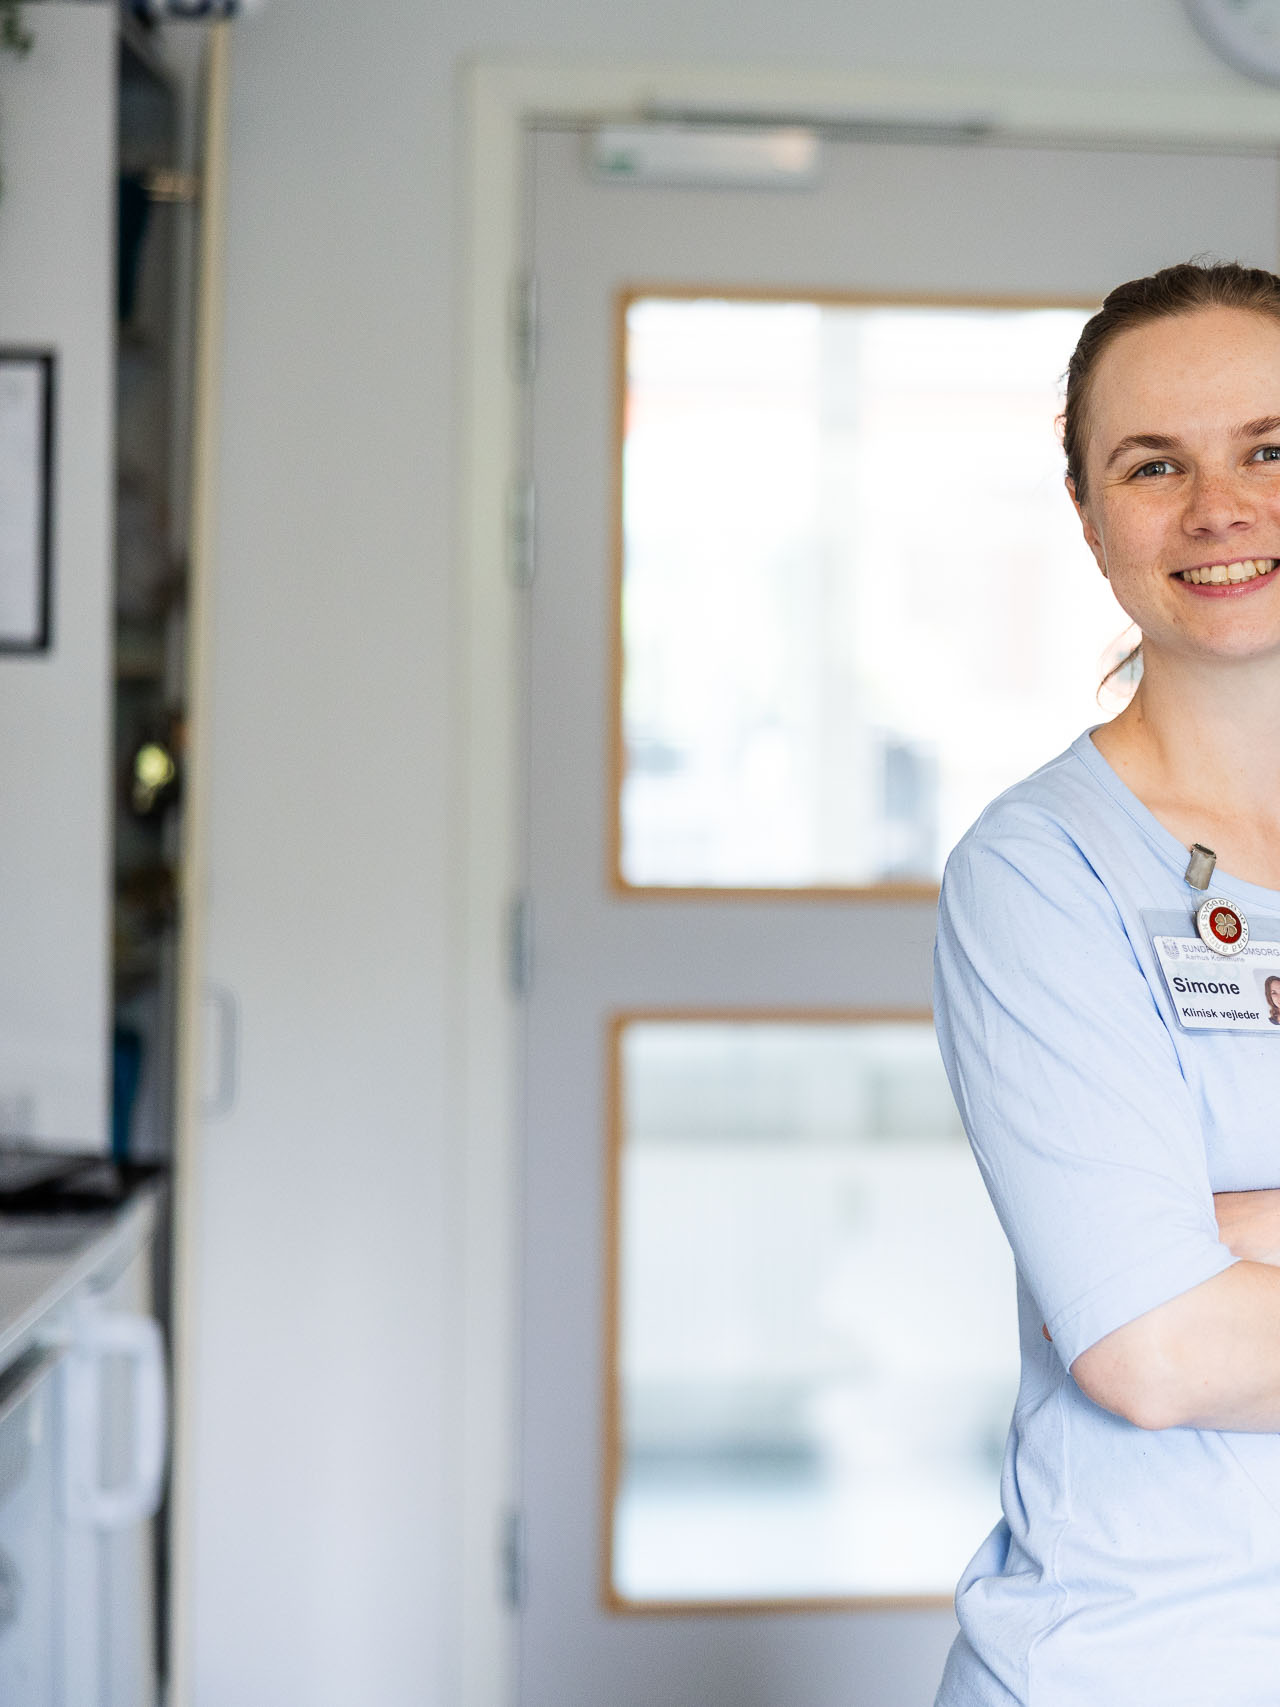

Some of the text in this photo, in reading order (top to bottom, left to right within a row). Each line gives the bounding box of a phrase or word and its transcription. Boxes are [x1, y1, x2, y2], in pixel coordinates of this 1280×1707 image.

[1242, 947, 1280, 957] OMSORG
[1172, 976, 1240, 995] Simone
[1181, 1007, 1260, 1021] Klinisk vejleder
